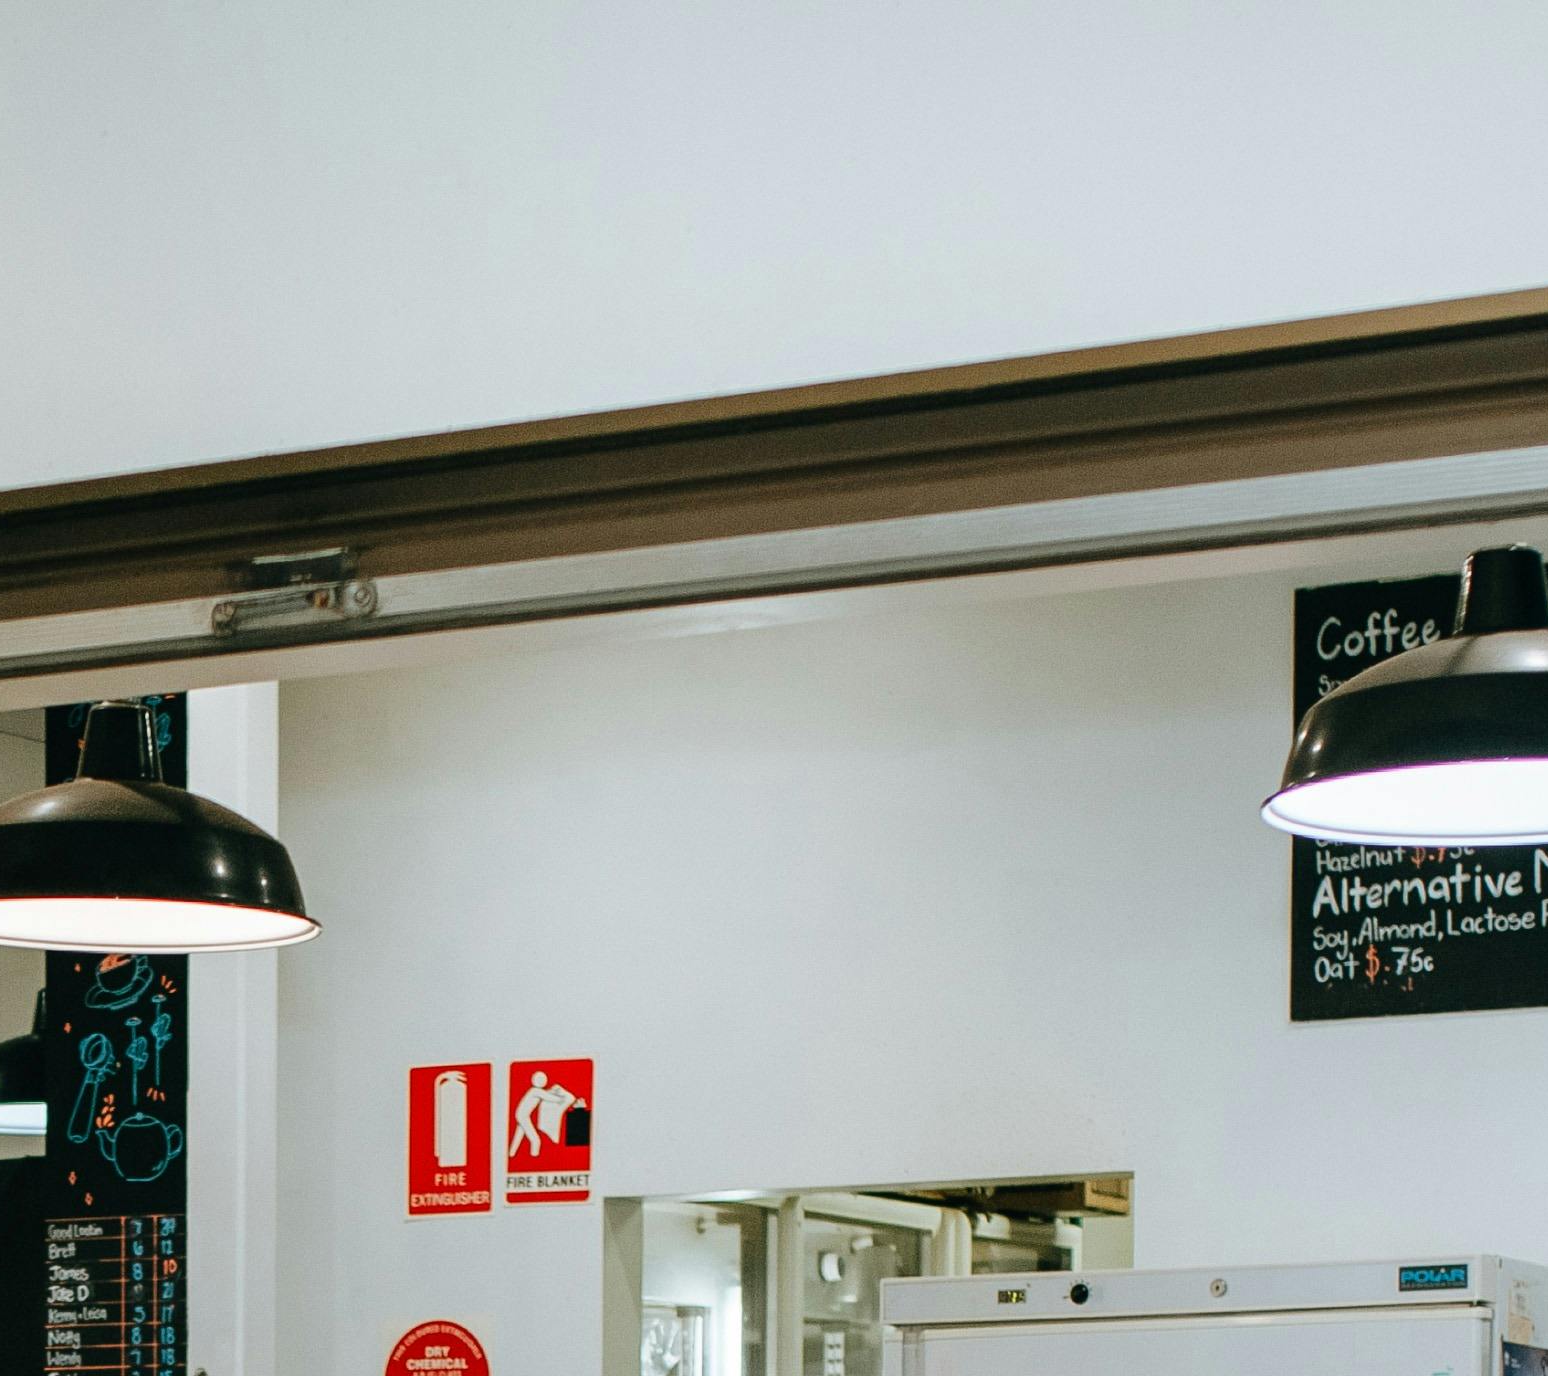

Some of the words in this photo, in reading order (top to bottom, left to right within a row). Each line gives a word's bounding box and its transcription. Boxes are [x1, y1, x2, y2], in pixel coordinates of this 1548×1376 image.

[1317, 608, 1442, 660] Coffee
[1316, 847, 1407, 874] Hazelnut
[1313, 863, 1523, 918] Alternative
[1447, 905, 1535, 936] Lactose
[1315, 952, 1359, 983] Oat
[434, 1172, 467, 1186] FIRE
[506, 1175, 533, 1188] FIRE
[537, 1174, 590, 1188] BLANKET
[411, 1191, 490, 1207] EXTINGUISHER
